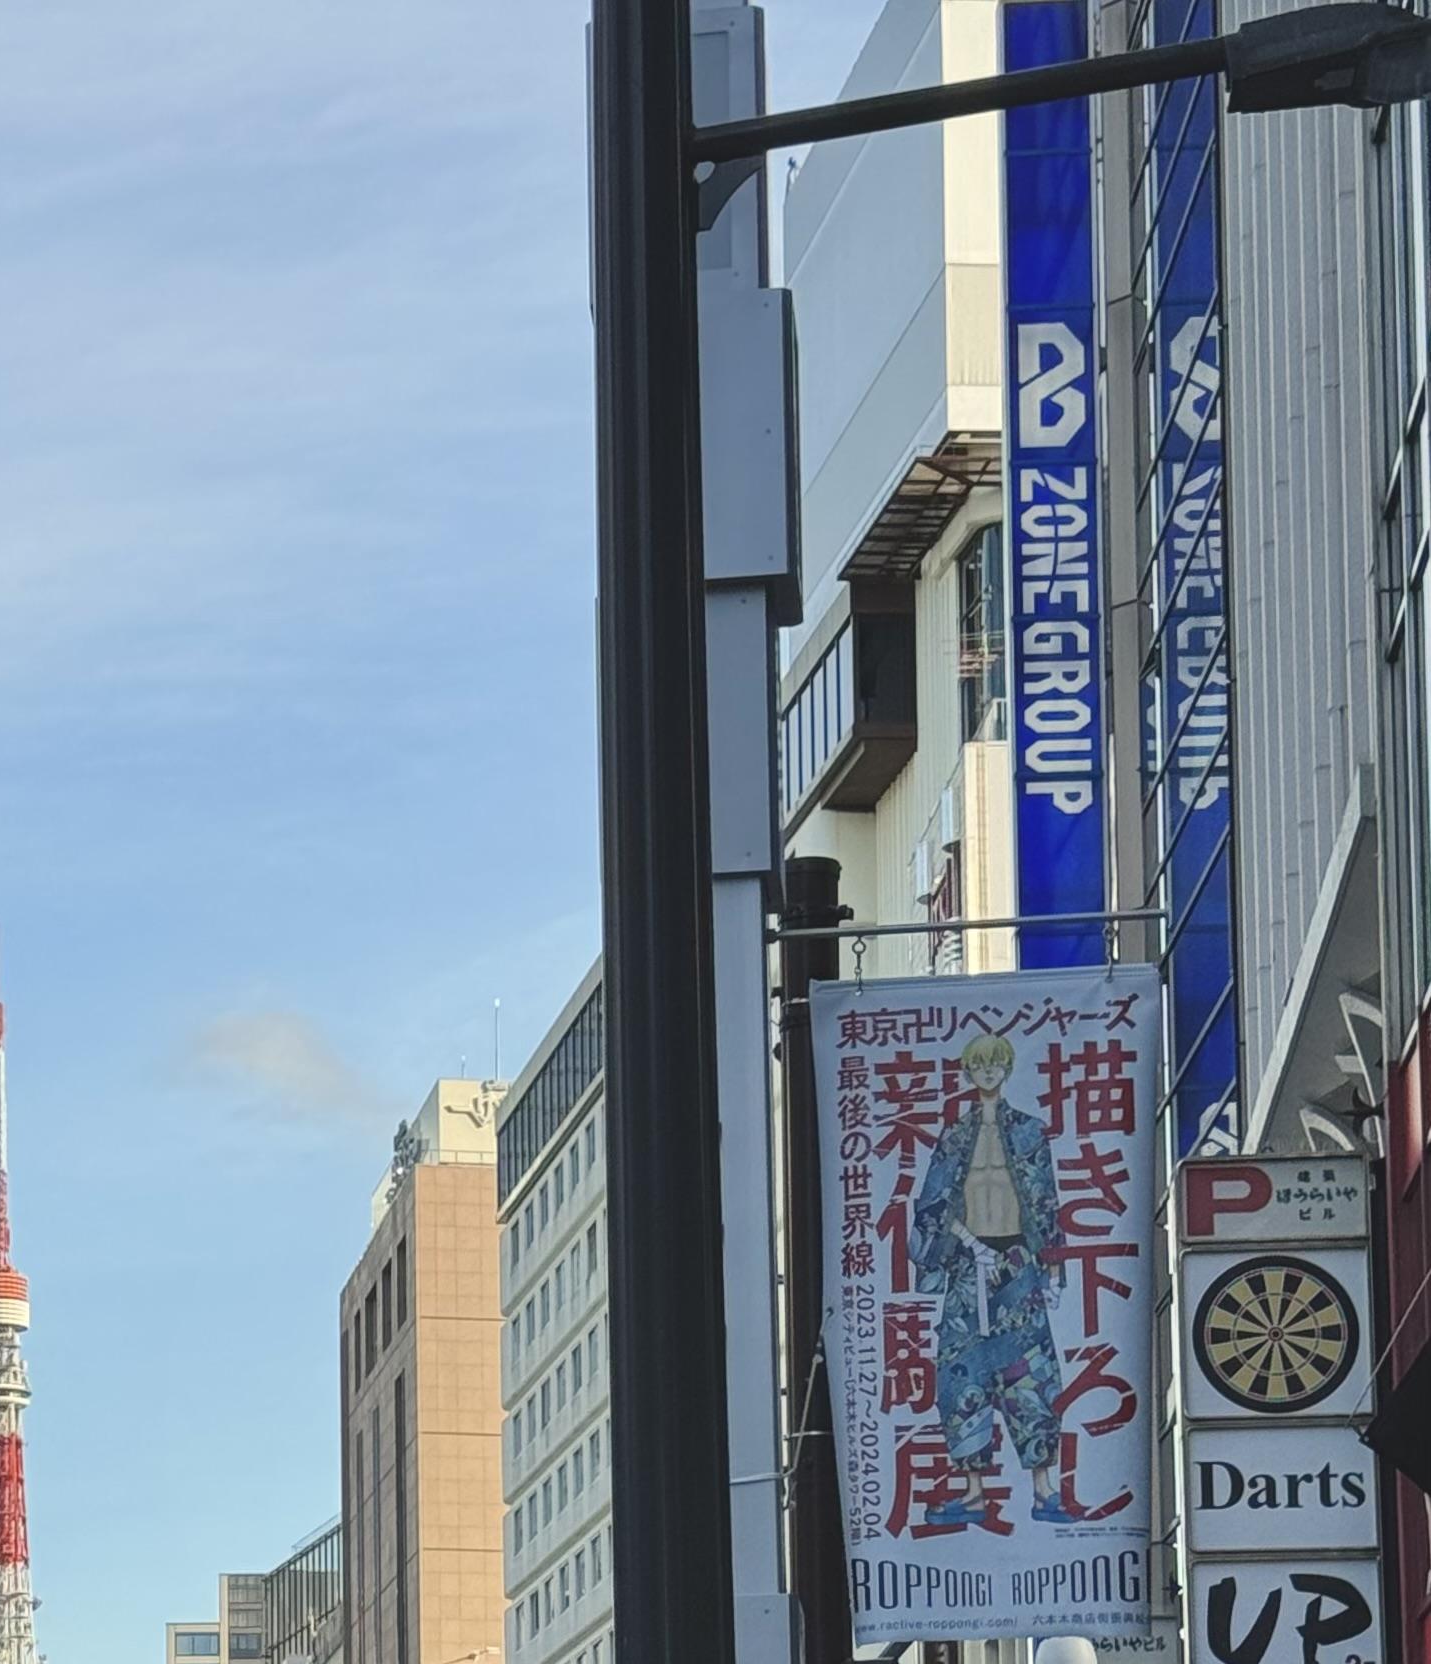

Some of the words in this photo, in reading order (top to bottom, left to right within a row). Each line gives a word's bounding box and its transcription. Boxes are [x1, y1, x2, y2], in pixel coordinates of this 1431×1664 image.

[1018, 322, 1085, 448] B
[1019, 466, 1090, 615] ZONE
[1022, 619, 1093, 815] GROUP
[835, 992, 1140, 1050] 東京卍リベンジャーズ
[836, 1055, 876, 1279] 最後の世界線
[1185, 1166, 1273, 1237] P
[1275, 1188, 1360, 1205] ほうらいや
[1037, 1038, 1141, 1522] 描き下ろし
[1194, 1459, 1367, 1512] Darts
[850, 1557, 994, 1613] ROPPONGI
